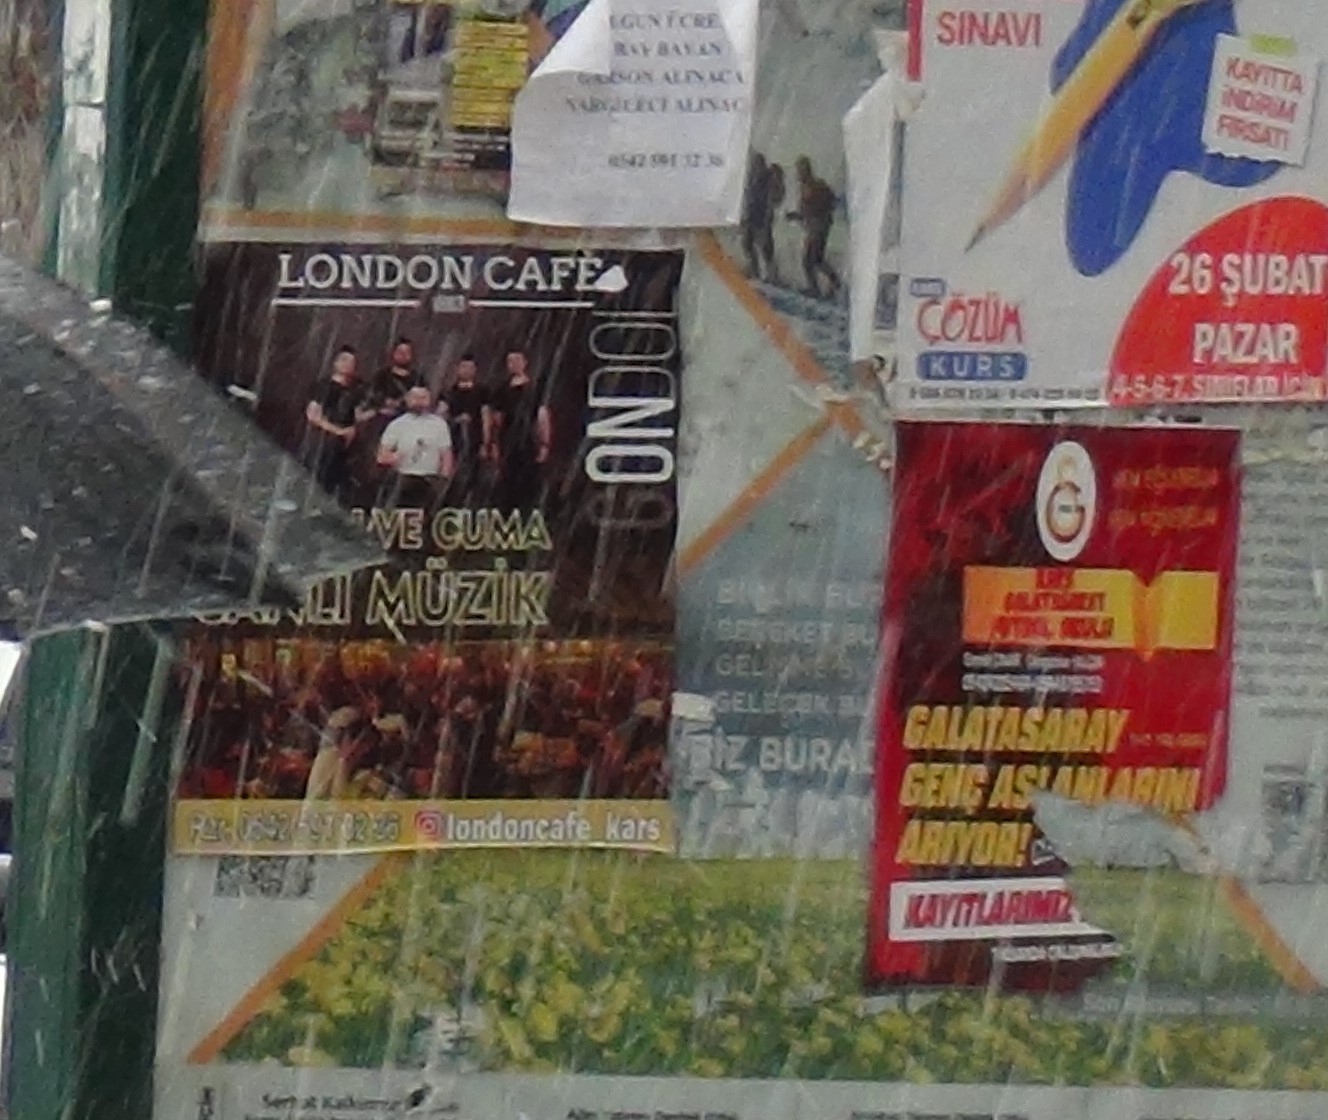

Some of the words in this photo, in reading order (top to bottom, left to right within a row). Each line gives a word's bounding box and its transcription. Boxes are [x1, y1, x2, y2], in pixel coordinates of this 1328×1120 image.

[938, 11, 1042, 47] SINAVI
[277, 252, 474, 291] LONDON
[1169, 252, 1213, 295] 26
[1221, 252, 1328, 306] ŞUBAT
[917, 291, 1025, 345] ÇÖZÜM
[929, 354, 1016, 378] KURS
[1192, 322, 1300, 365] PAZAR
[431, 508, 552, 551] CUMA
[366, 556, 550, 626] MÜZİK
[903, 705, 1131, 753] GALATASARAY
[899, 762, 990, 815] GENÇ
[895, 821, 1033, 868] ARIYOR!
